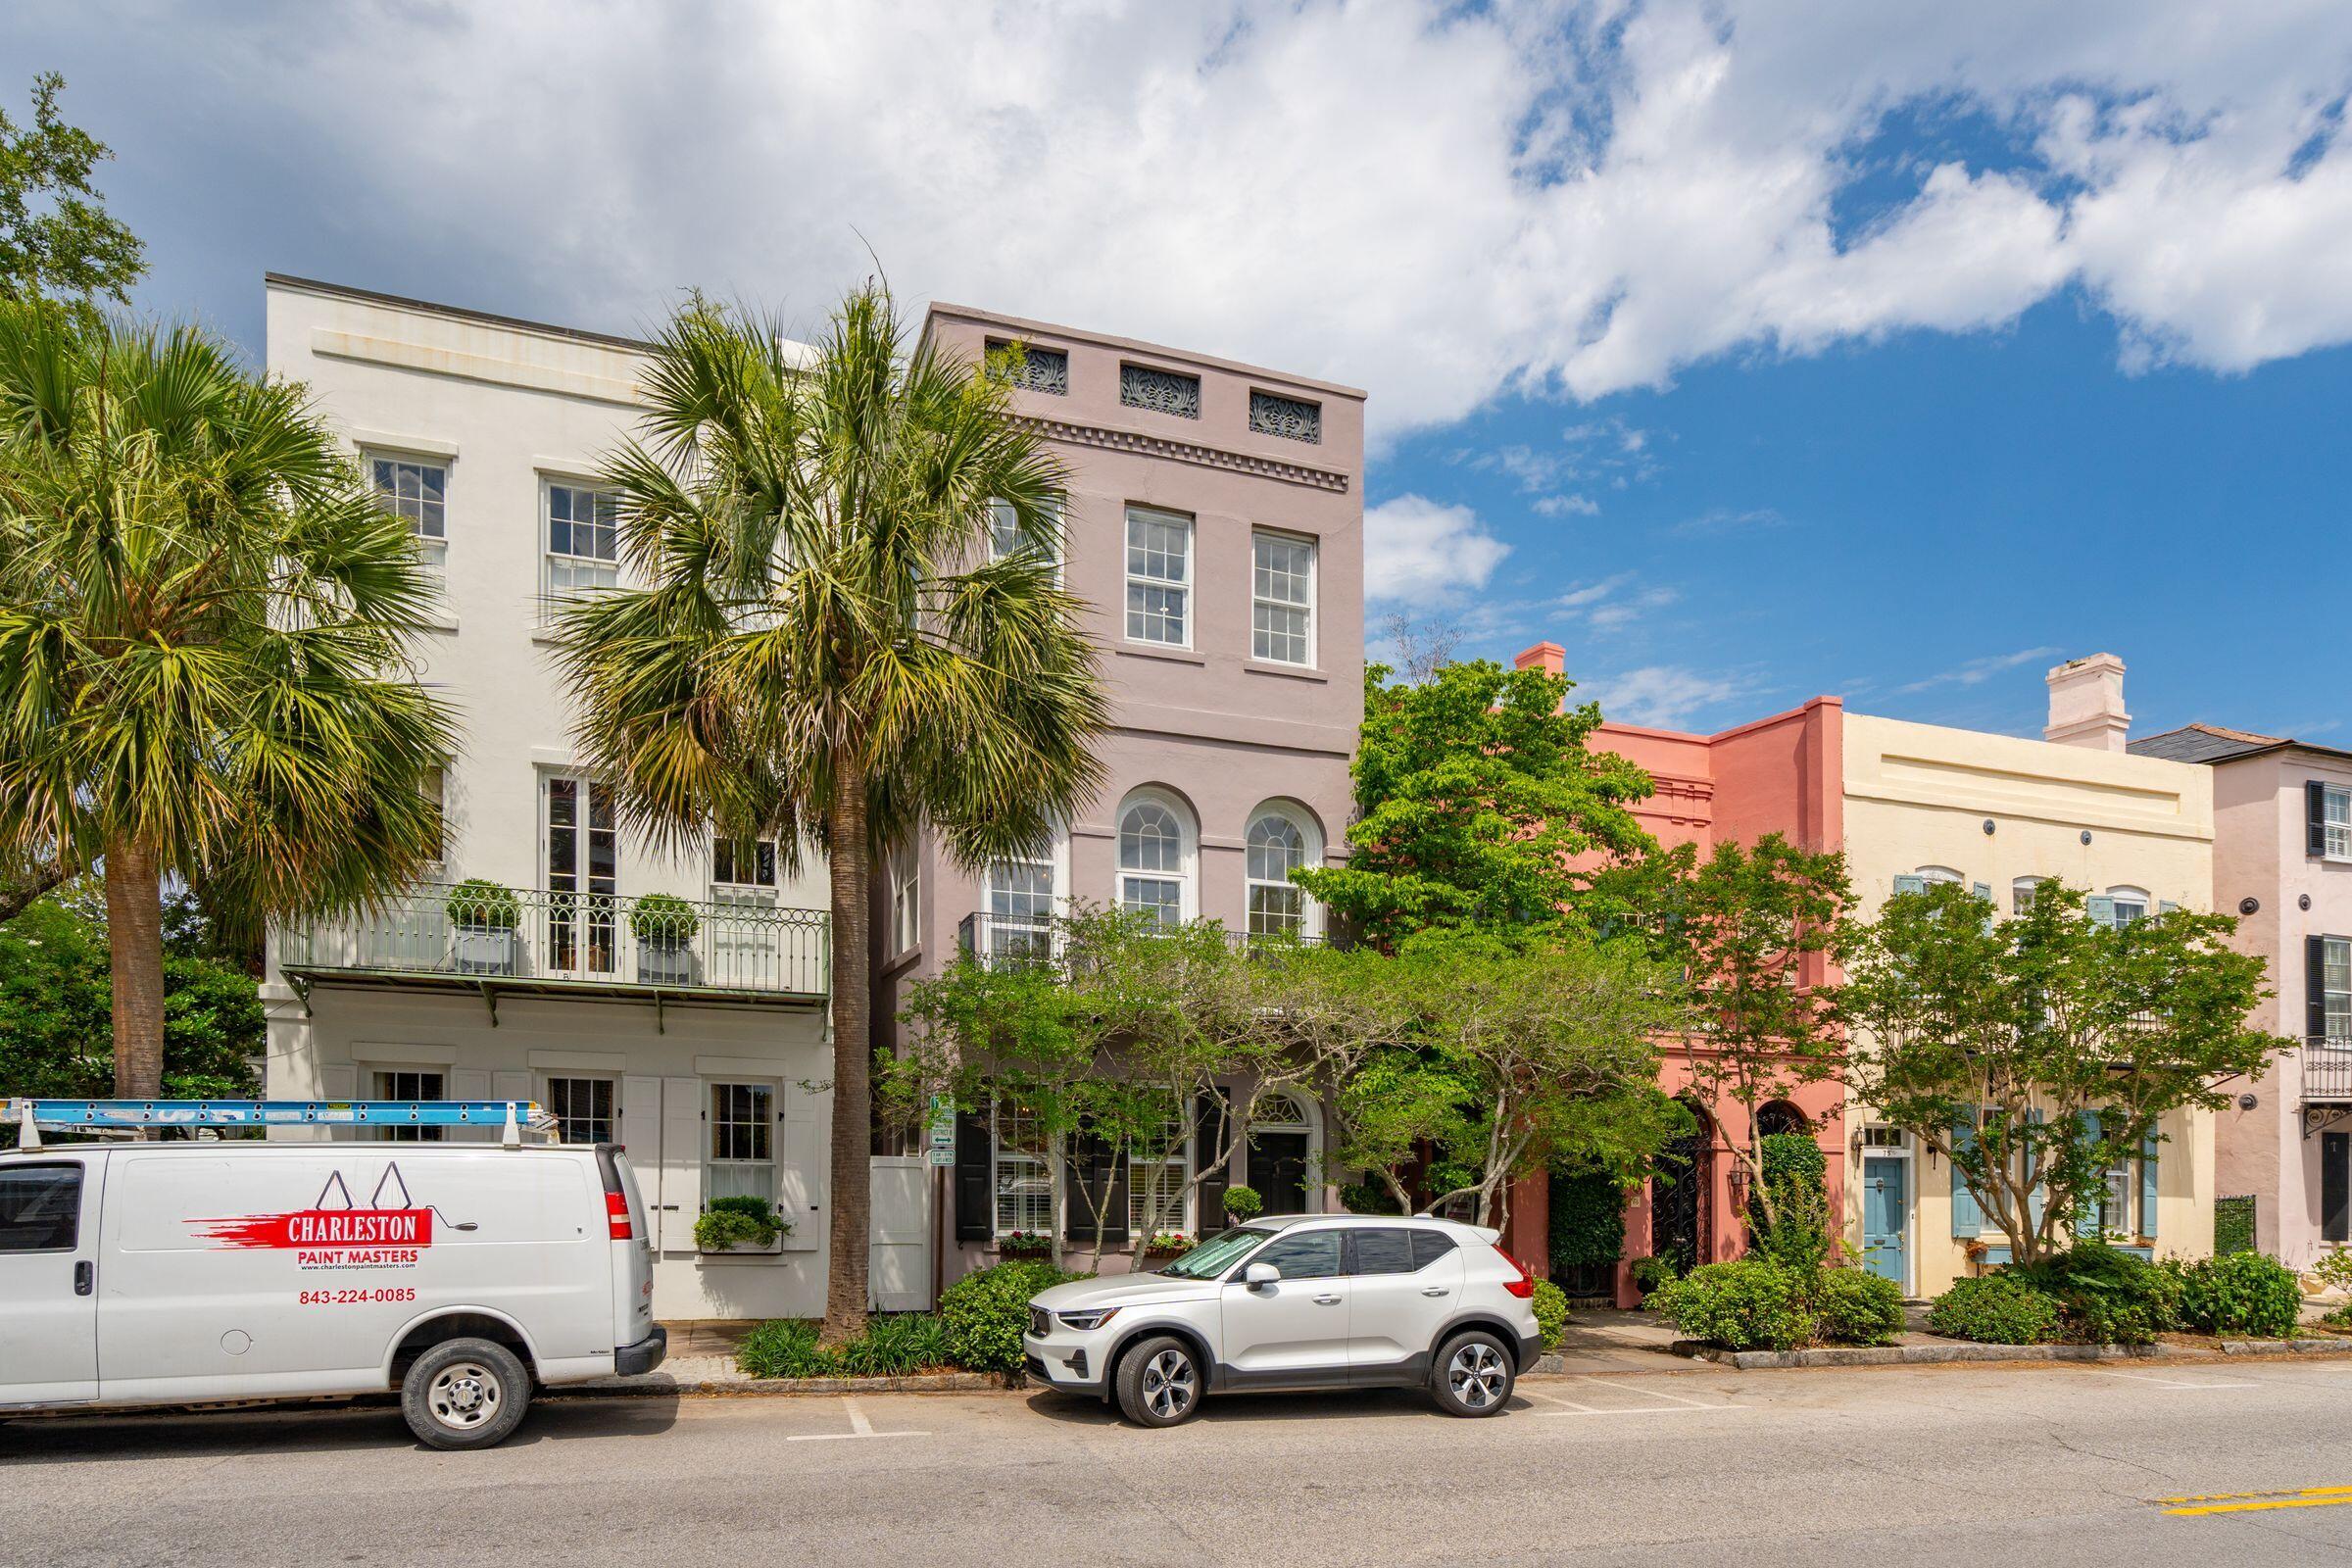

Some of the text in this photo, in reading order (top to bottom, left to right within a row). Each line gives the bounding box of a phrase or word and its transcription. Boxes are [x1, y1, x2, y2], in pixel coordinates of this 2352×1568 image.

[288, 1216, 416, 1242] CHARLESTON
[298, 1250, 418, 1264] PAINT MASTERS
[299, 1288, 416, 1304] 843-224-0085
